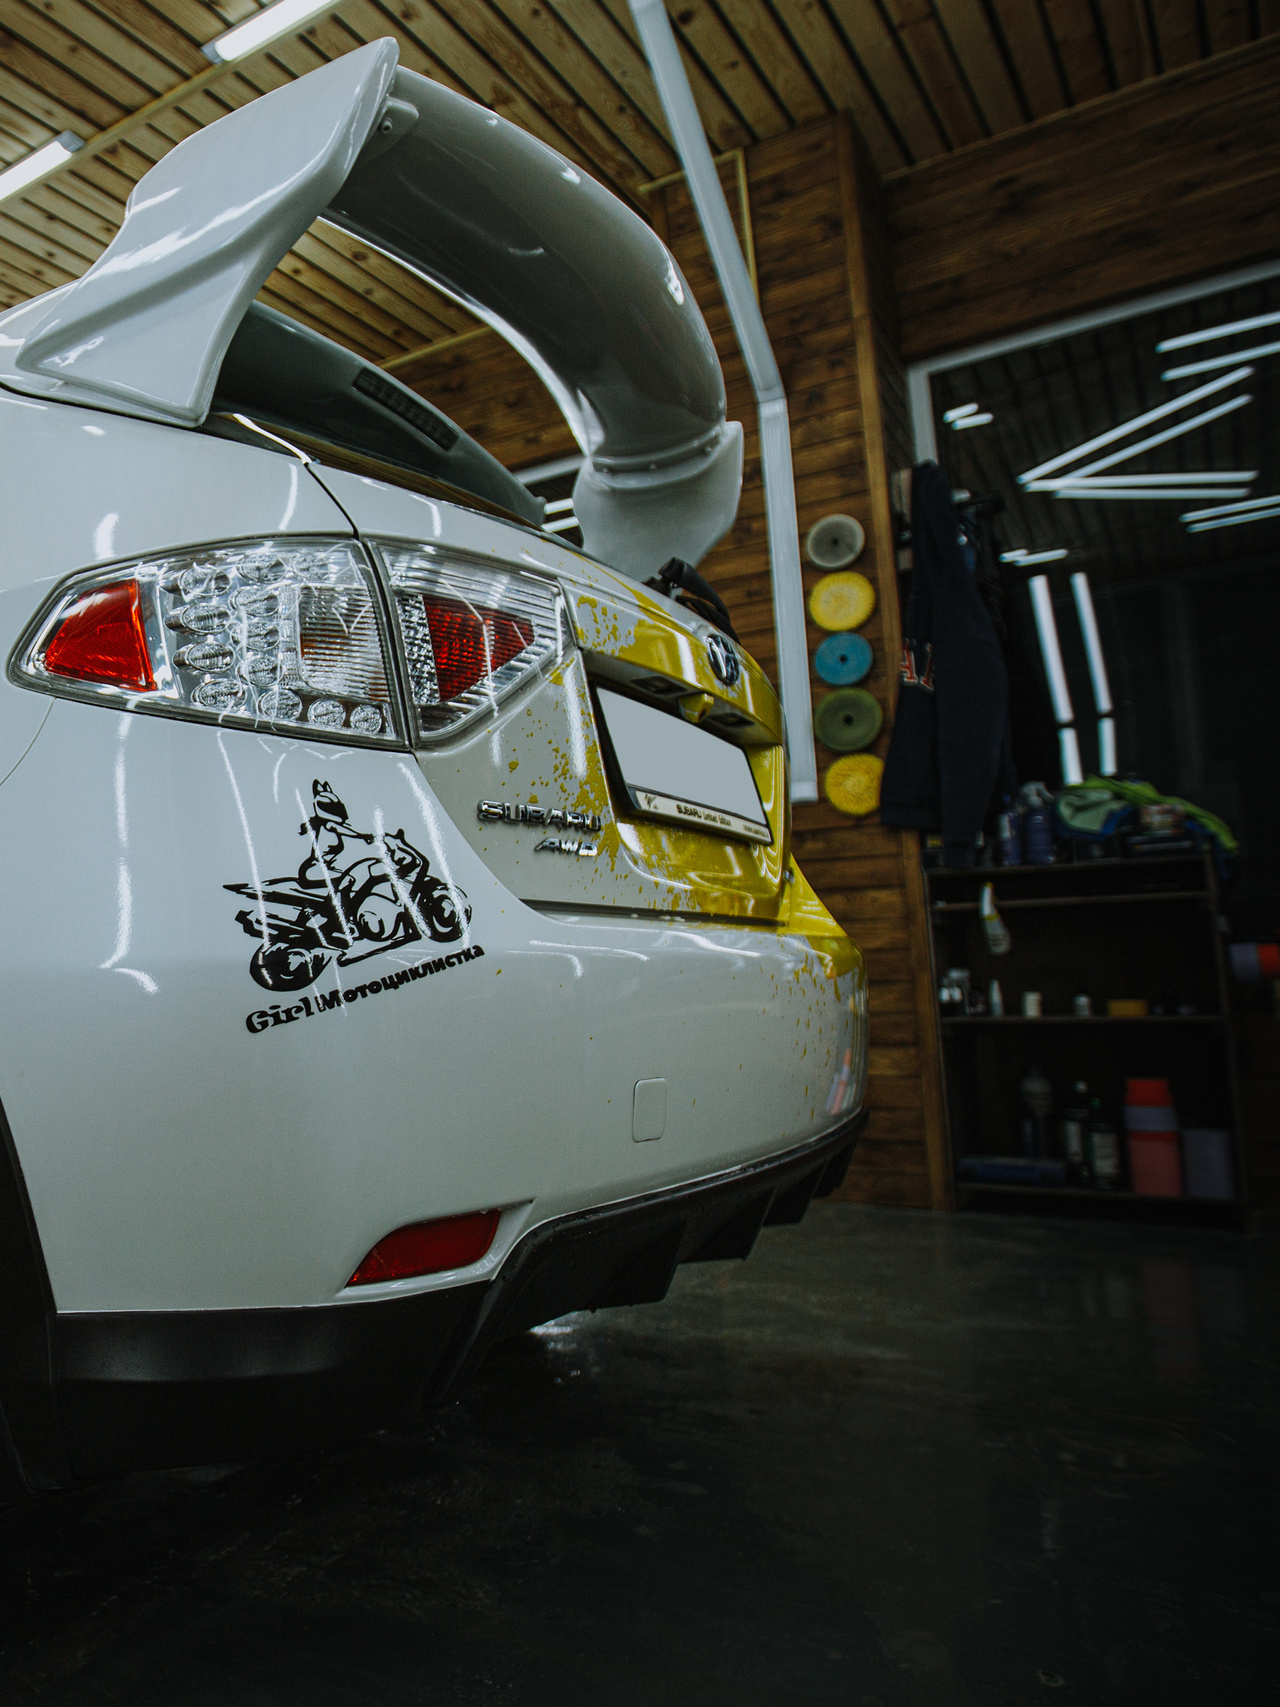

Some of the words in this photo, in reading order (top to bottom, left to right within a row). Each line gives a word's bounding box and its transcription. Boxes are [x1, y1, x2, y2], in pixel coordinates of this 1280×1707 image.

[477, 799, 601, 832] SUBARU
[675, 803, 702, 819] SUBARU
[534, 837, 598, 857] AWD
[245, 996, 315, 1034] Girl
[317, 944, 485, 1012] Мотоциклистка
